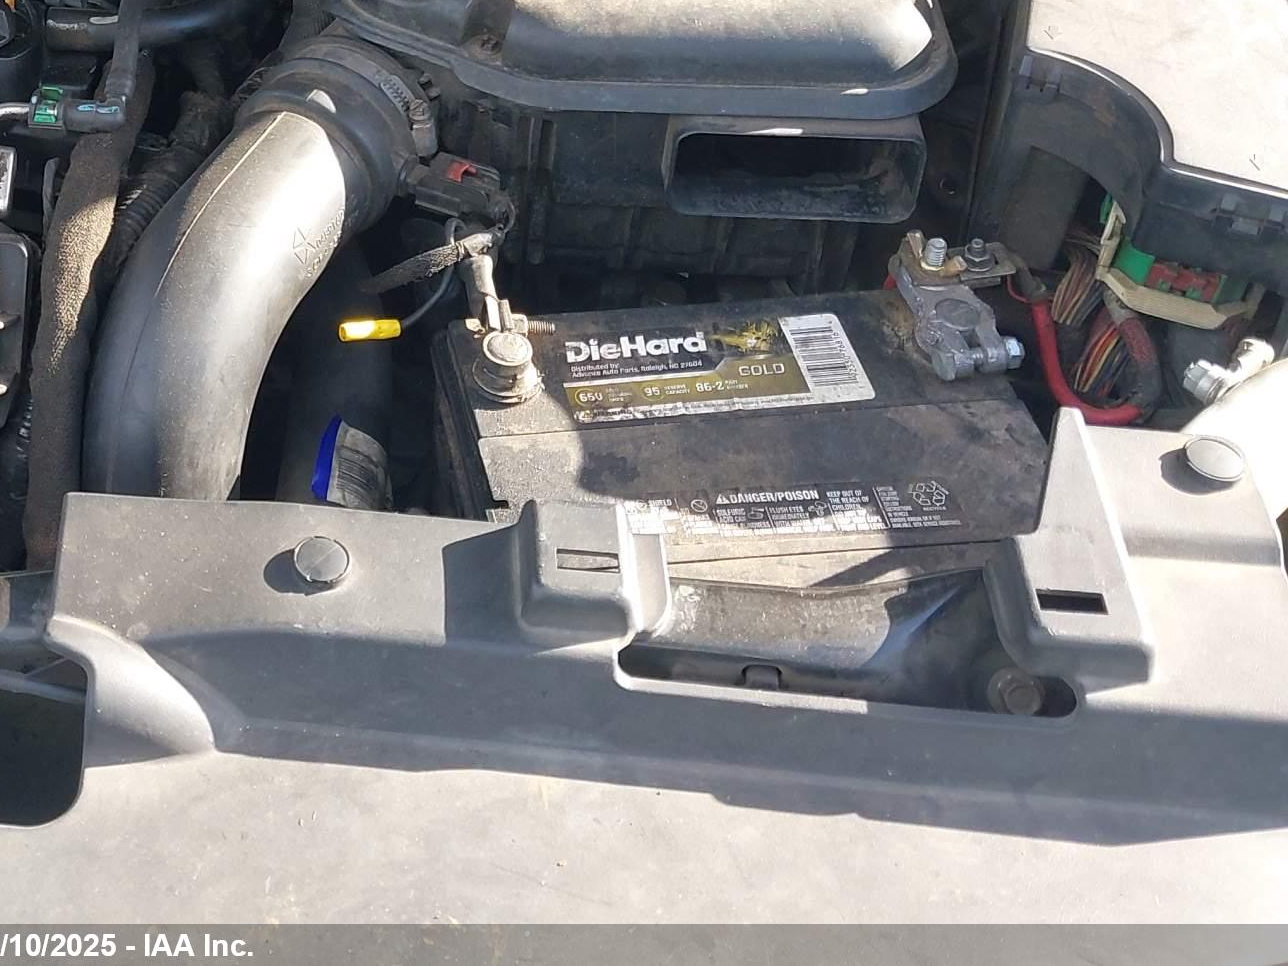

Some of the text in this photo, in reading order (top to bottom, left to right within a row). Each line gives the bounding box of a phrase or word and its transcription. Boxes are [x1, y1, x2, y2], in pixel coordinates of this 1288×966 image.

[564, 331, 708, 364] DieHard
[570, 364, 609, 373] Distributed
[572, 370, 601, 379] Advance
[602, 368, 619, 377] Auto
[738, 363, 785, 377] GOLD
[643, 386, 661, 397] 95
[695, 381, 726, 393] 86-2
[579, 390, 604, 403] 650
[729, 490, 820, 505] DANGER/POISON
